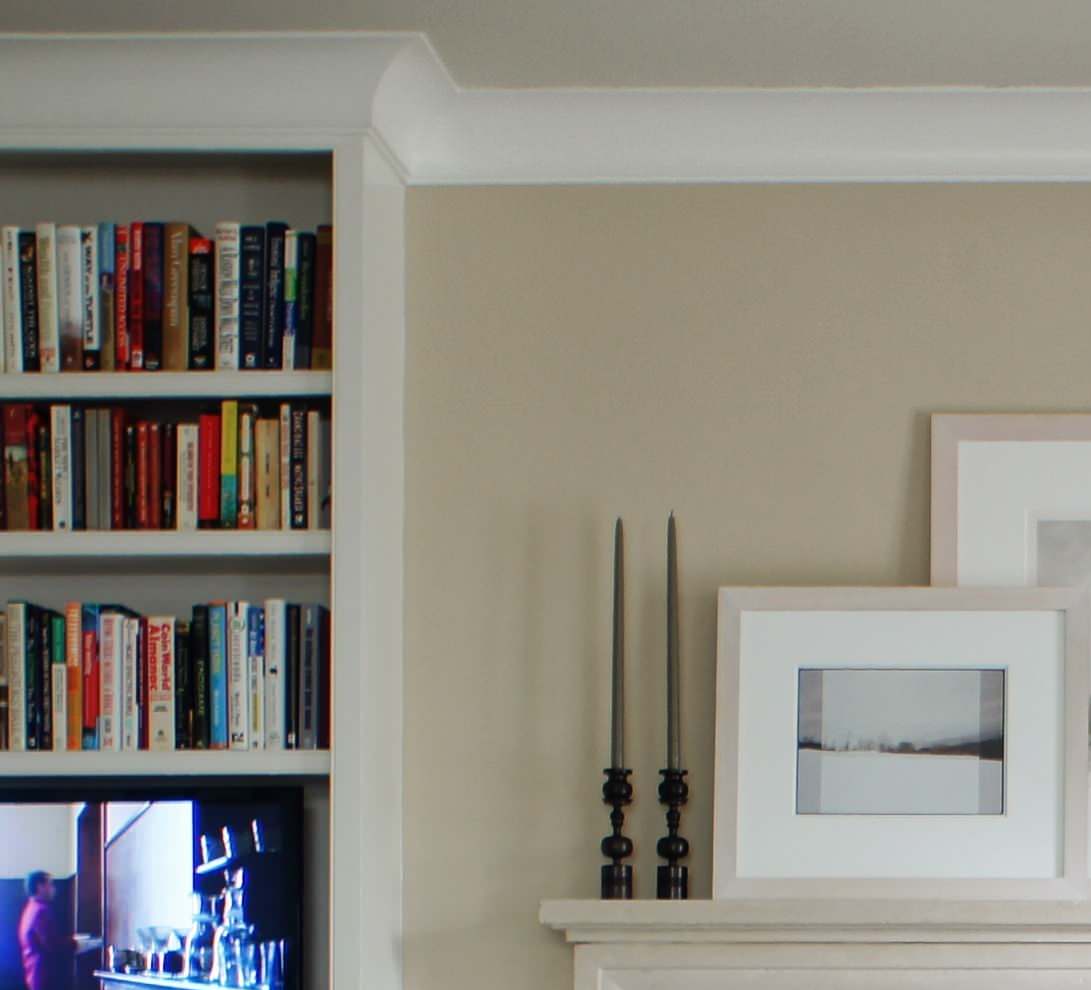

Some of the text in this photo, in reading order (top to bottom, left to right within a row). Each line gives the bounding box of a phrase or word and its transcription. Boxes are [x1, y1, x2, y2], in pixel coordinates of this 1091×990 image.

[149, 624, 161, 691] Almanac
[162, 623, 172, 690] Coin World
